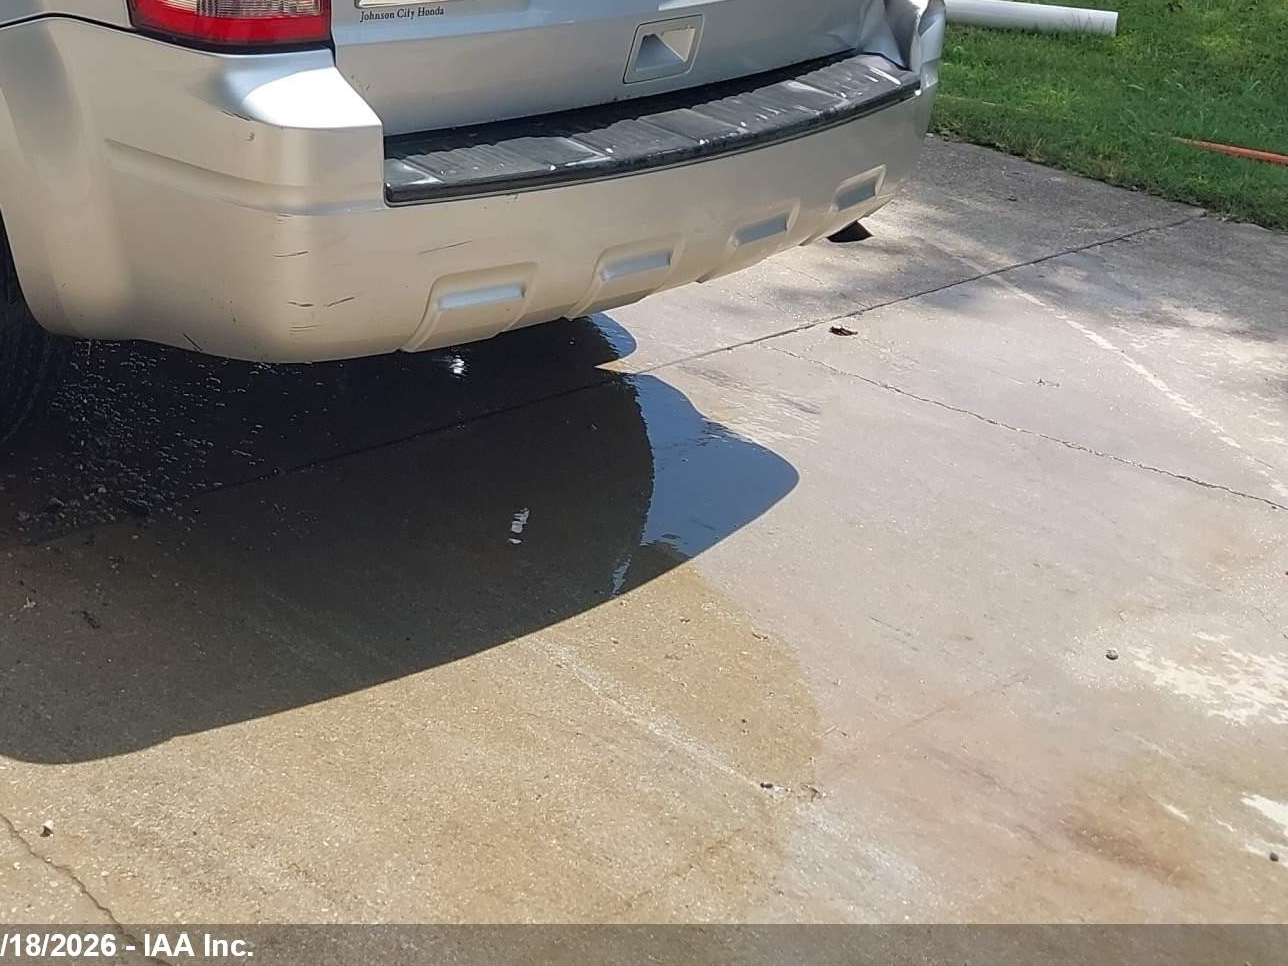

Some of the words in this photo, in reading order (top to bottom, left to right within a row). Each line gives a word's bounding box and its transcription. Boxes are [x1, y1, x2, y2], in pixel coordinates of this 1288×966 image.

[360, 10, 395, 22] Johnson
[396, 8, 415, 20] City
[417, 6, 445, 17] Honda
